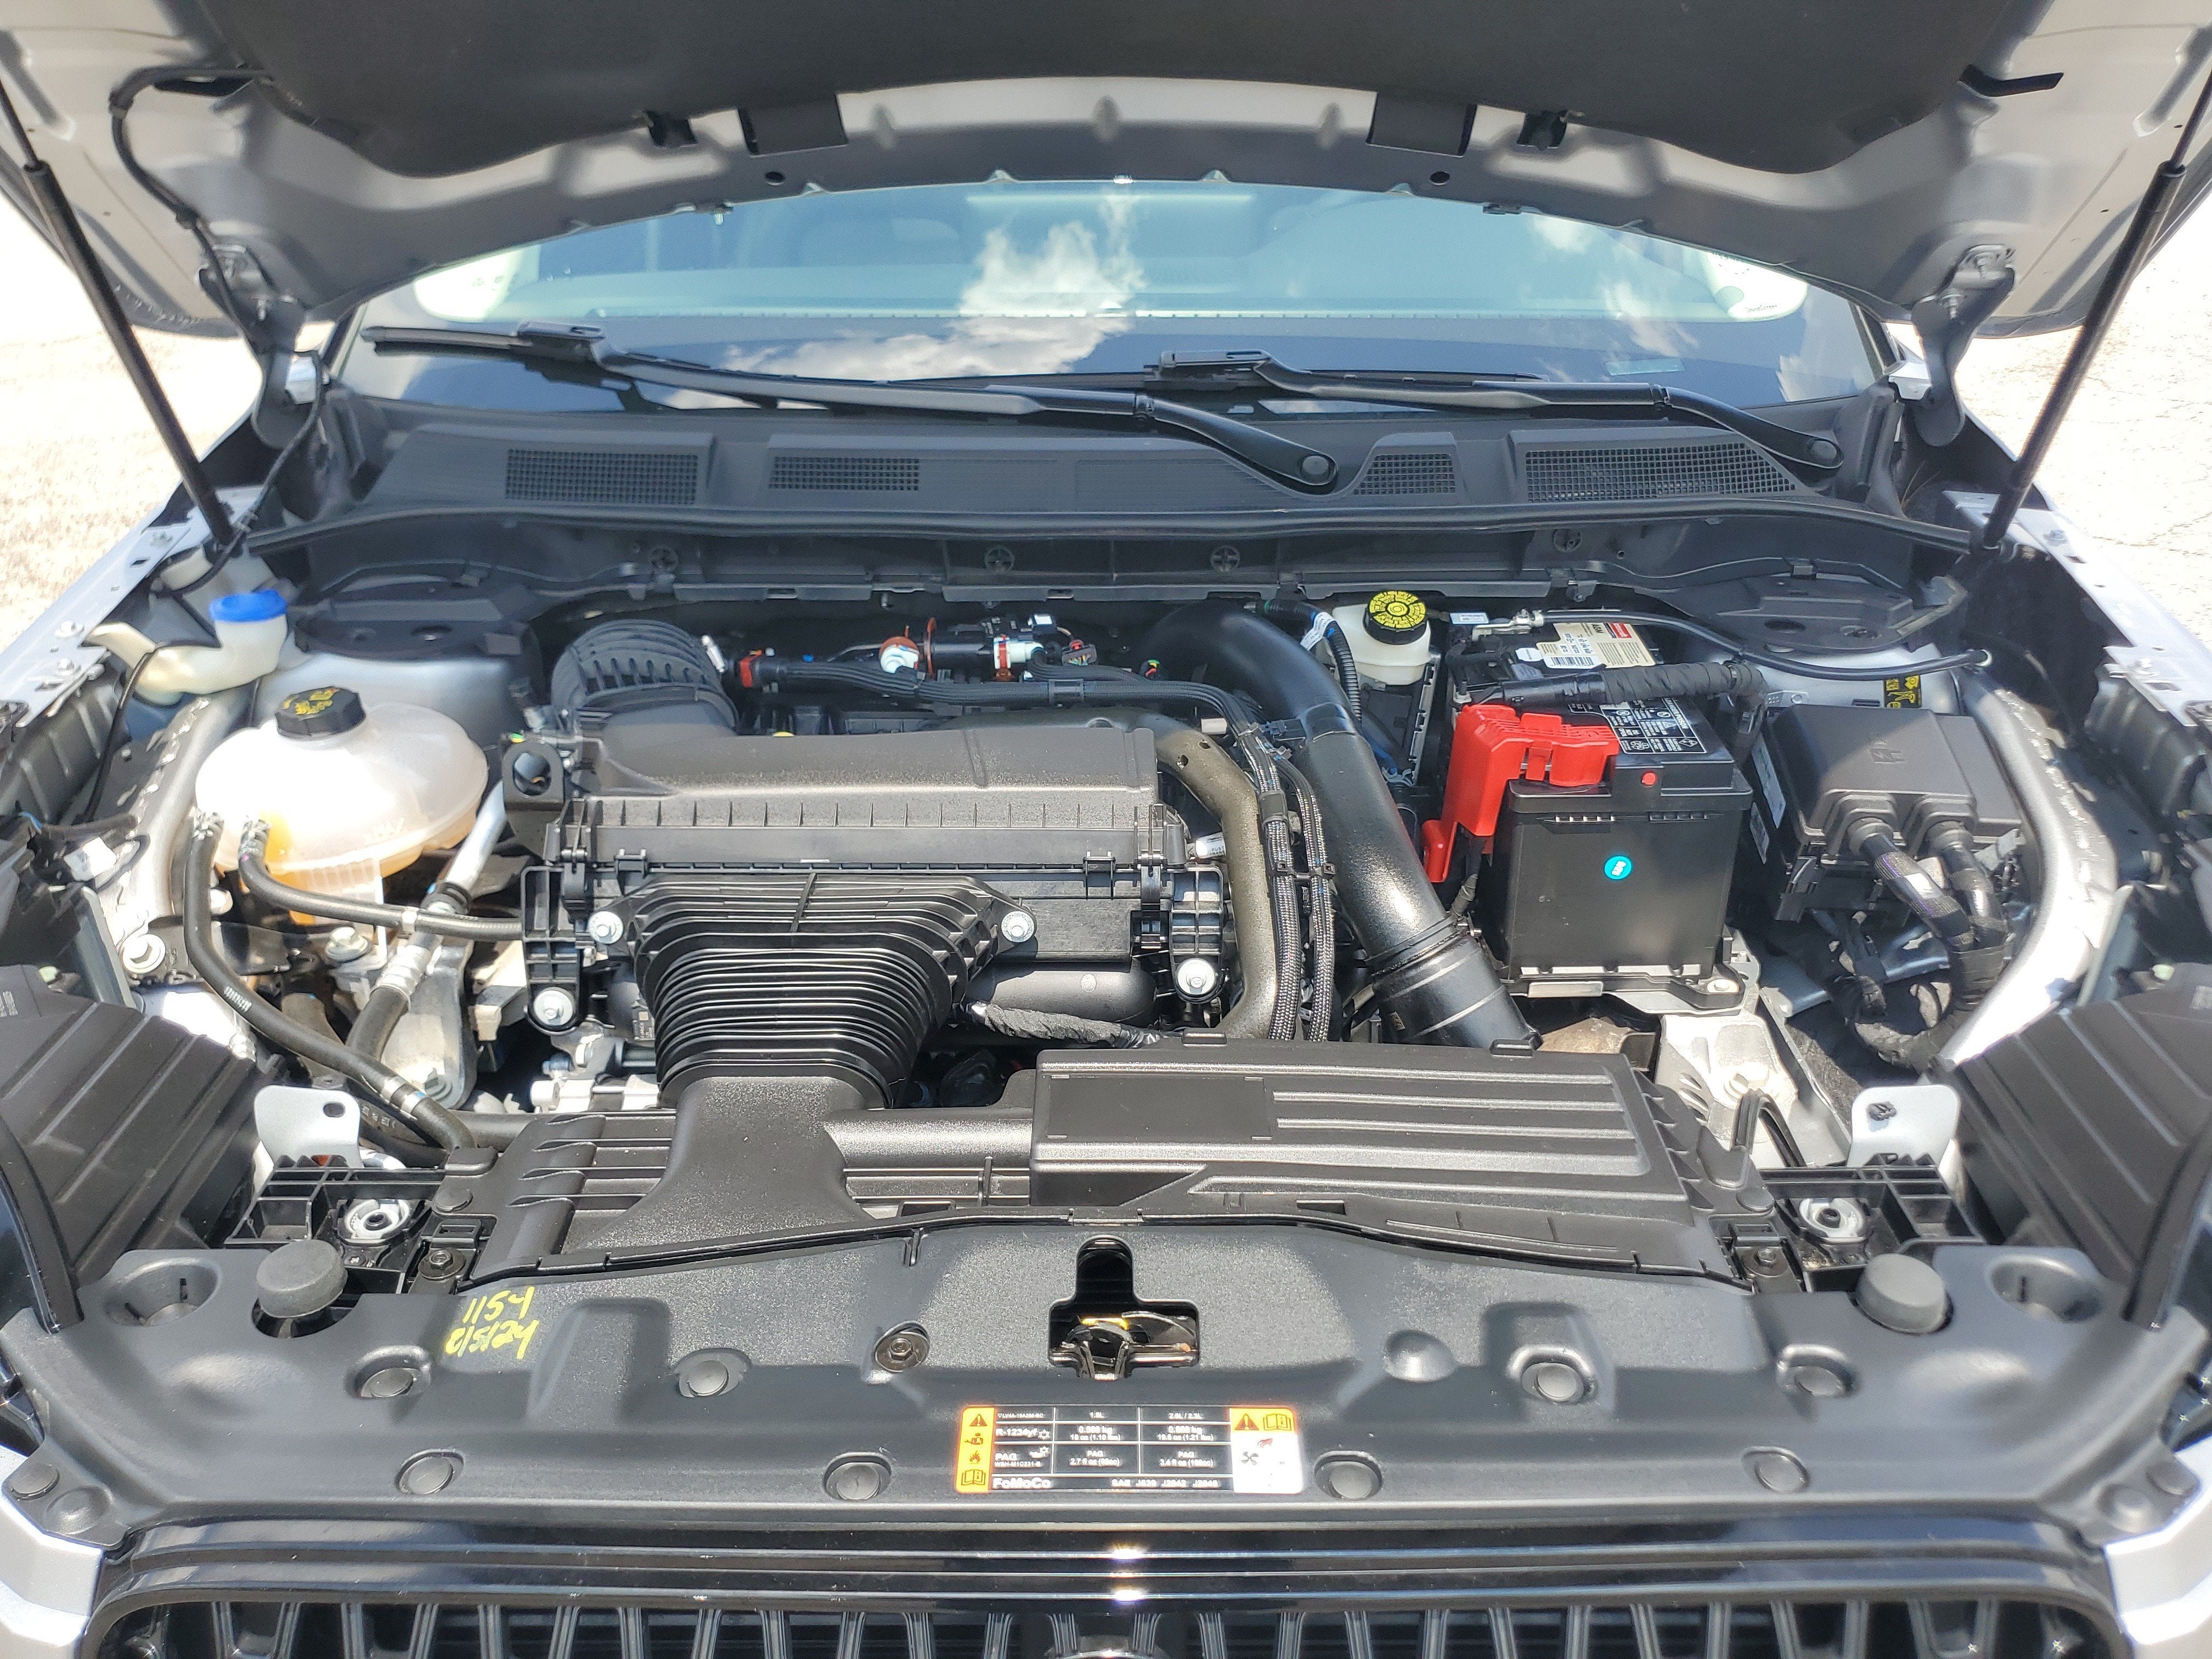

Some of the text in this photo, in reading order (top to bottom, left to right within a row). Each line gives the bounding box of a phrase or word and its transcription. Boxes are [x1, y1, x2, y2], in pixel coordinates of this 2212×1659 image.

[1591, 624, 1604, 634] AGM
[462, 1285, 535, 1324] 1154
[996, 1428, 1037, 1437] R-1234yf
[993, 1477, 1052, 1488] FoMoCo
